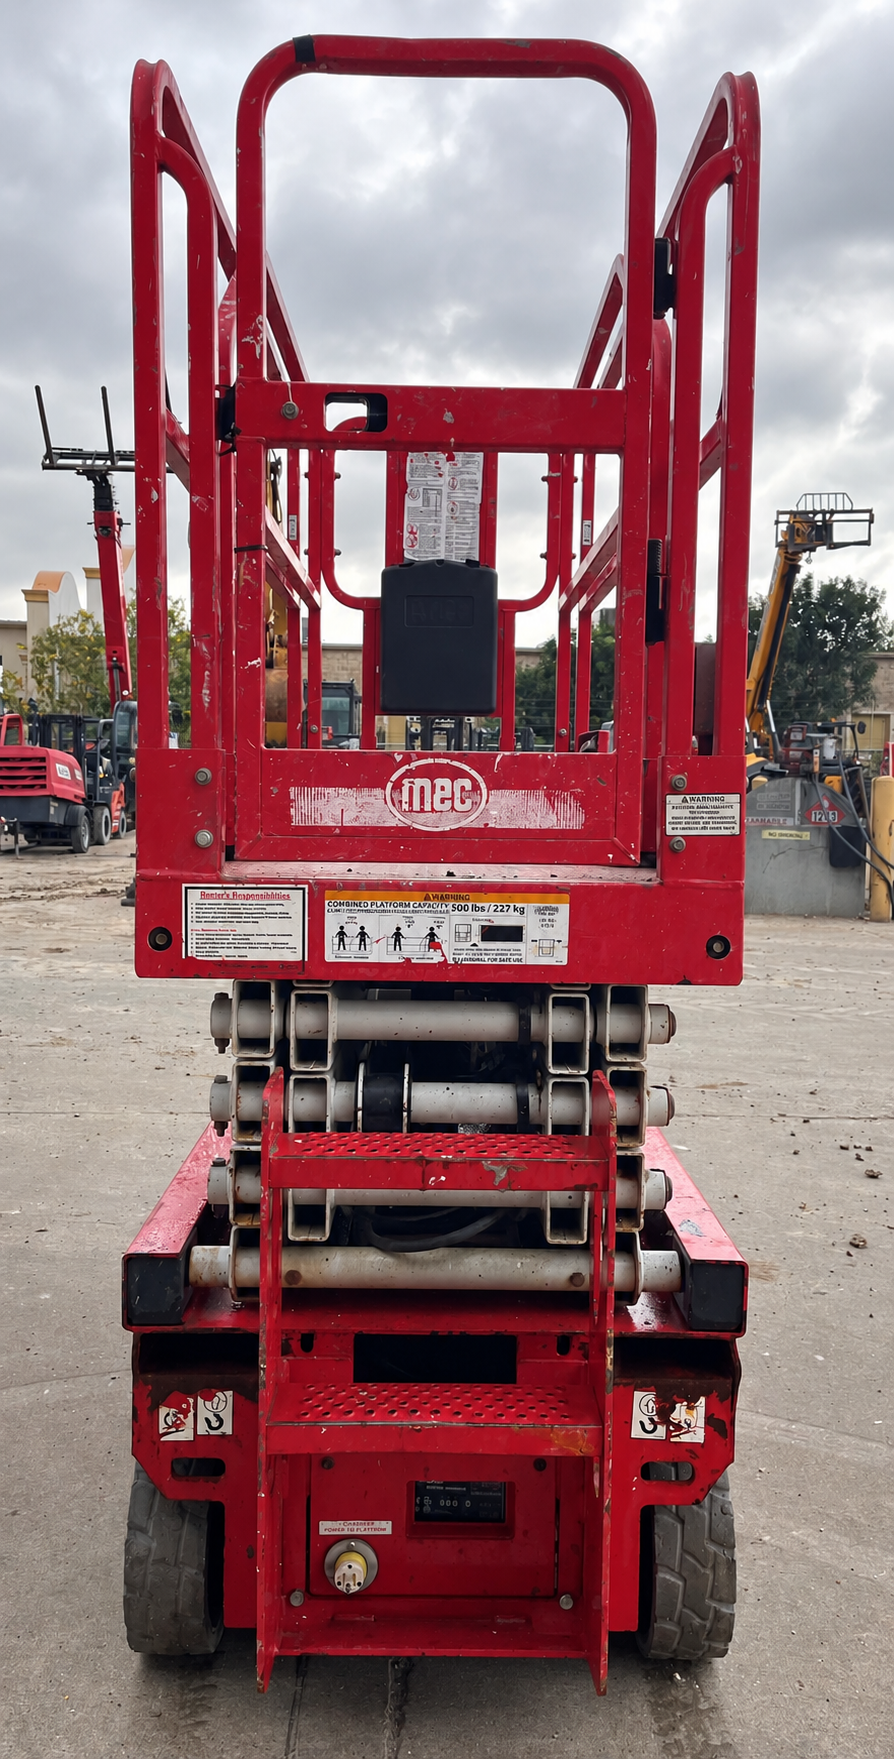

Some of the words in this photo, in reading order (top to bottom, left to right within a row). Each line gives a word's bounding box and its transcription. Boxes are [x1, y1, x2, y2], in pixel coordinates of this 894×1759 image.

[200, 891, 230, 899] Renter's
[232, 891, 291, 900] Responsibilities
[451, 903, 469, 912] 500
[471, 903, 486, 913] lbs
[493, 904, 511, 913] 227
[513, 904, 525, 915] kg
